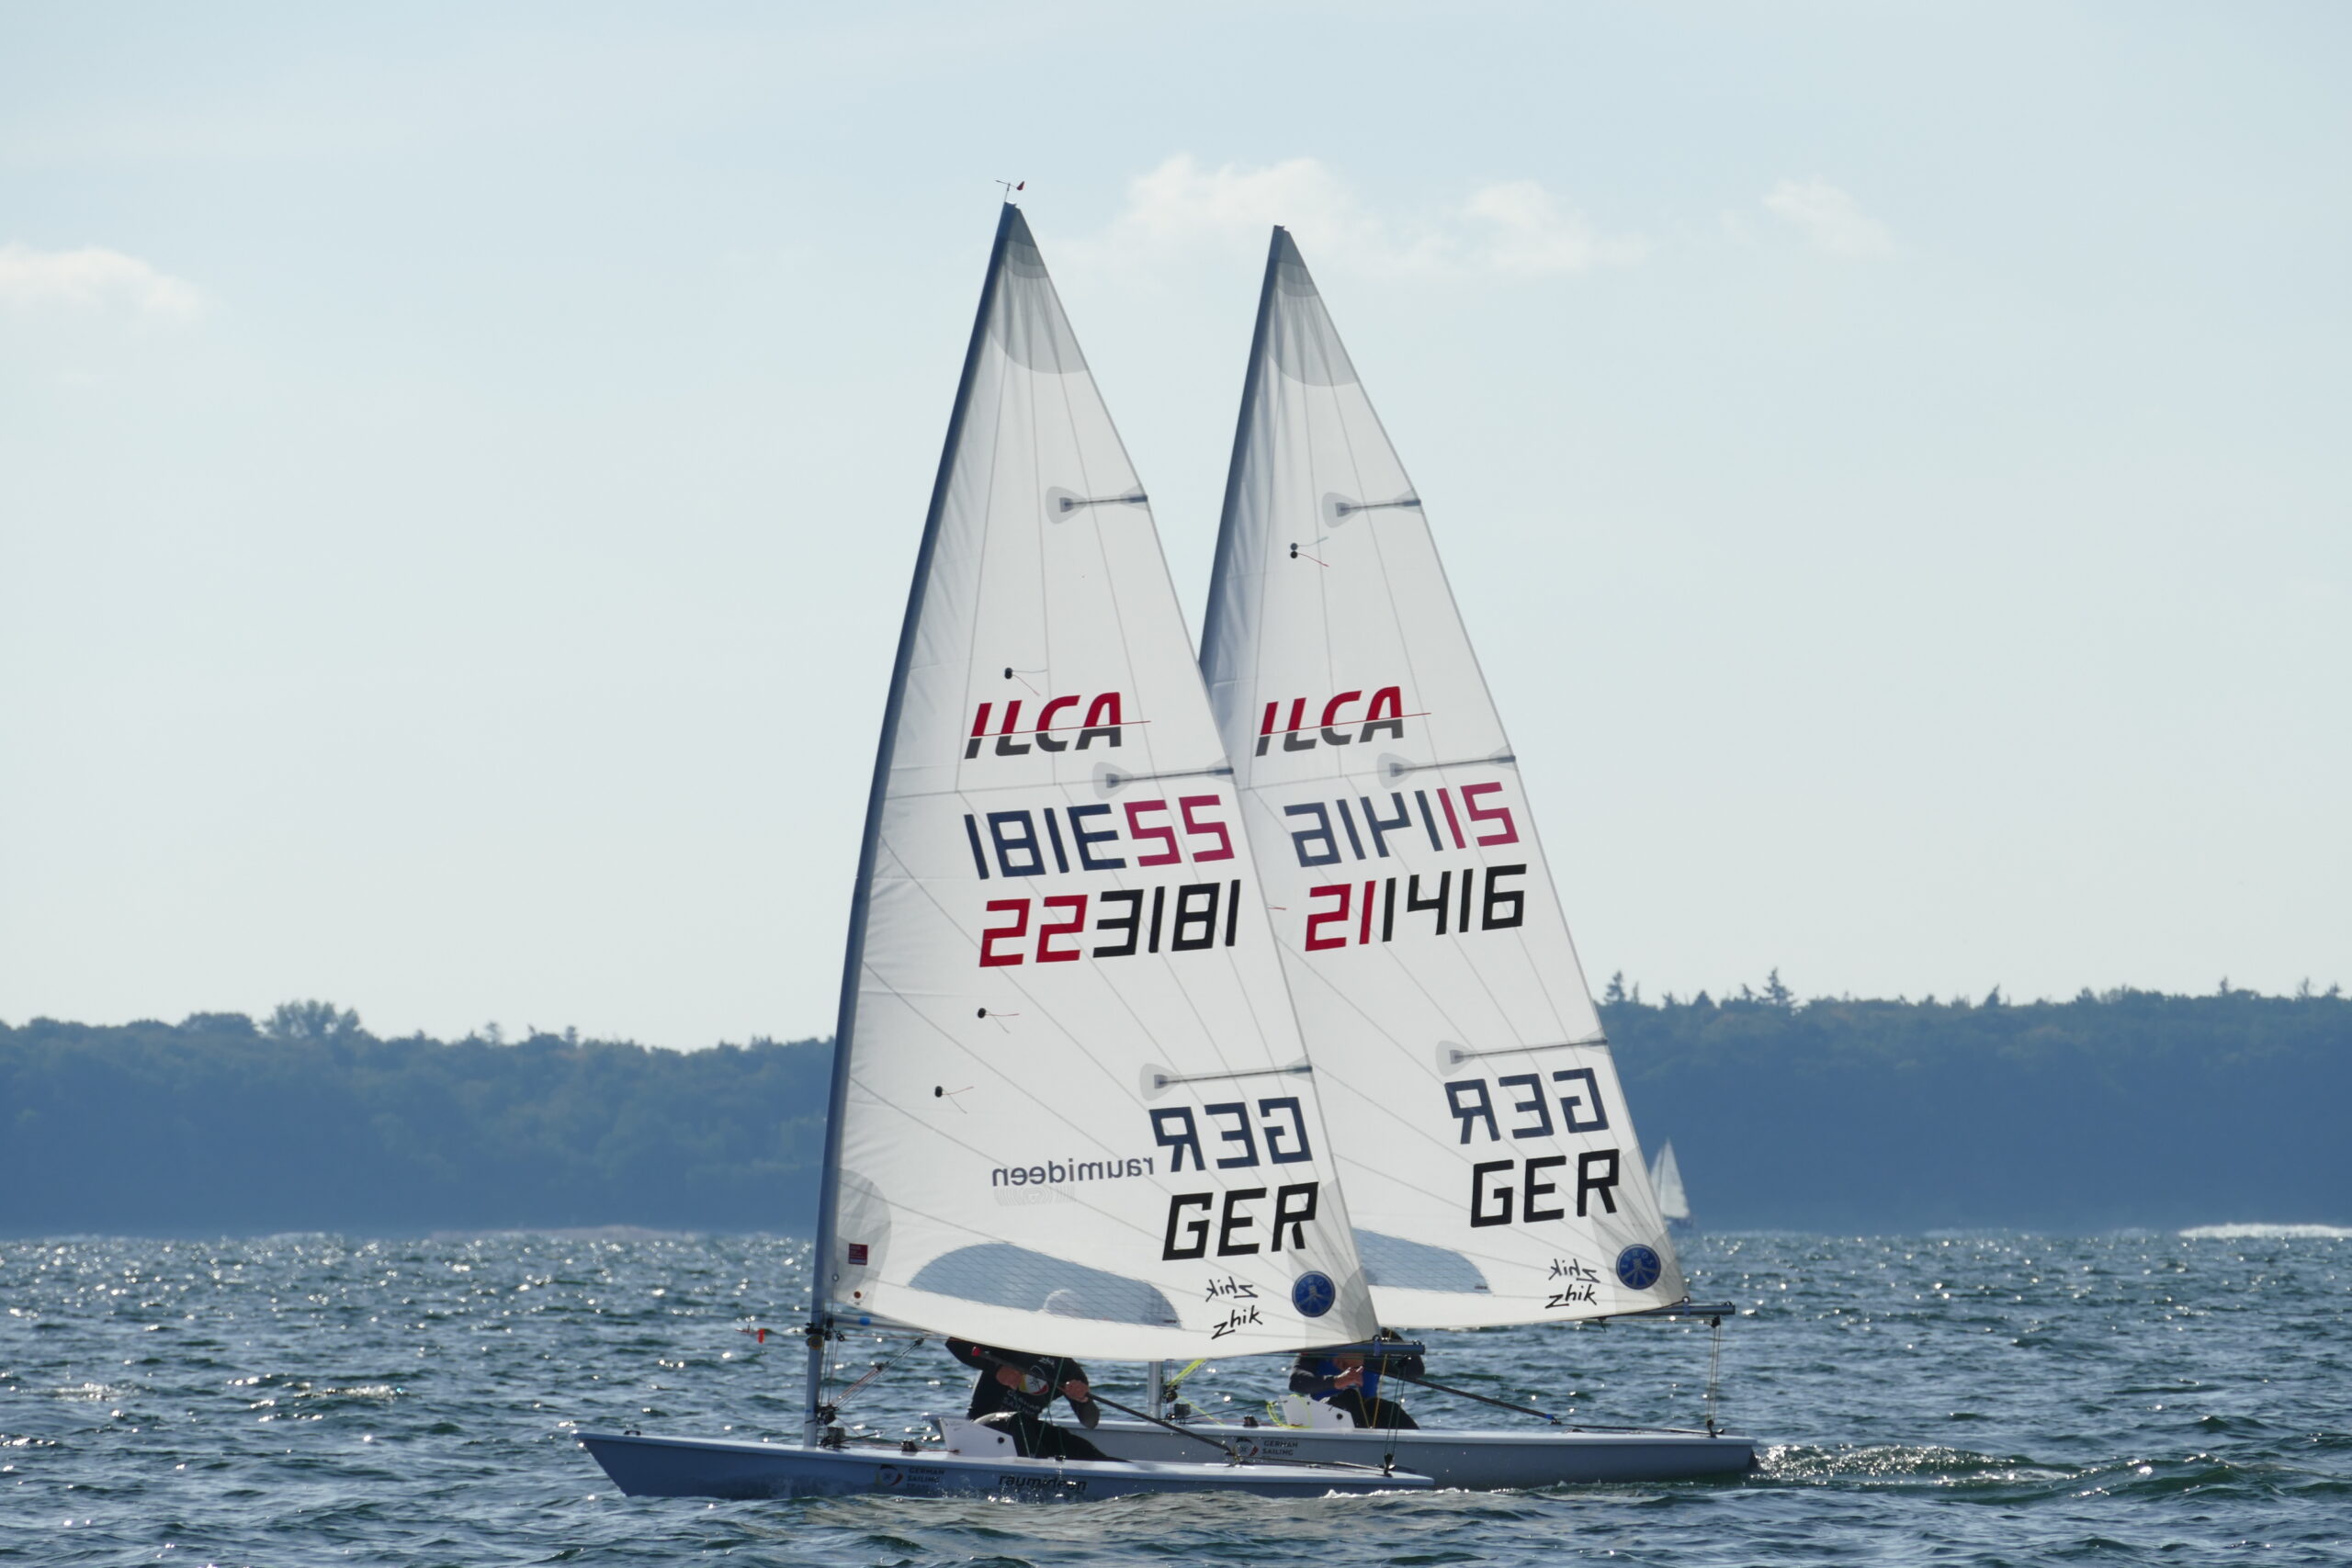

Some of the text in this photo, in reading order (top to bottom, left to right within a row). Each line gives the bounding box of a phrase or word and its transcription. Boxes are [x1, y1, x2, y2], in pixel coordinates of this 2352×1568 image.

[964, 692, 1122, 759] ILCA
[1255, 686, 1404, 757] ILCA
[979, 879, 1240, 967] 223181
[1305, 863, 1527, 952] 211416
[1161, 1182, 1319, 1261] GER
[1470, 1149, 1620, 1228] GER
[1211, 1304, 1263, 1340] zhik
[1544, 1283, 1598, 1309] zhik
[1261, 1448, 1295, 1456] SAILING
[1263, 1439, 1298, 1449] GERMAN
